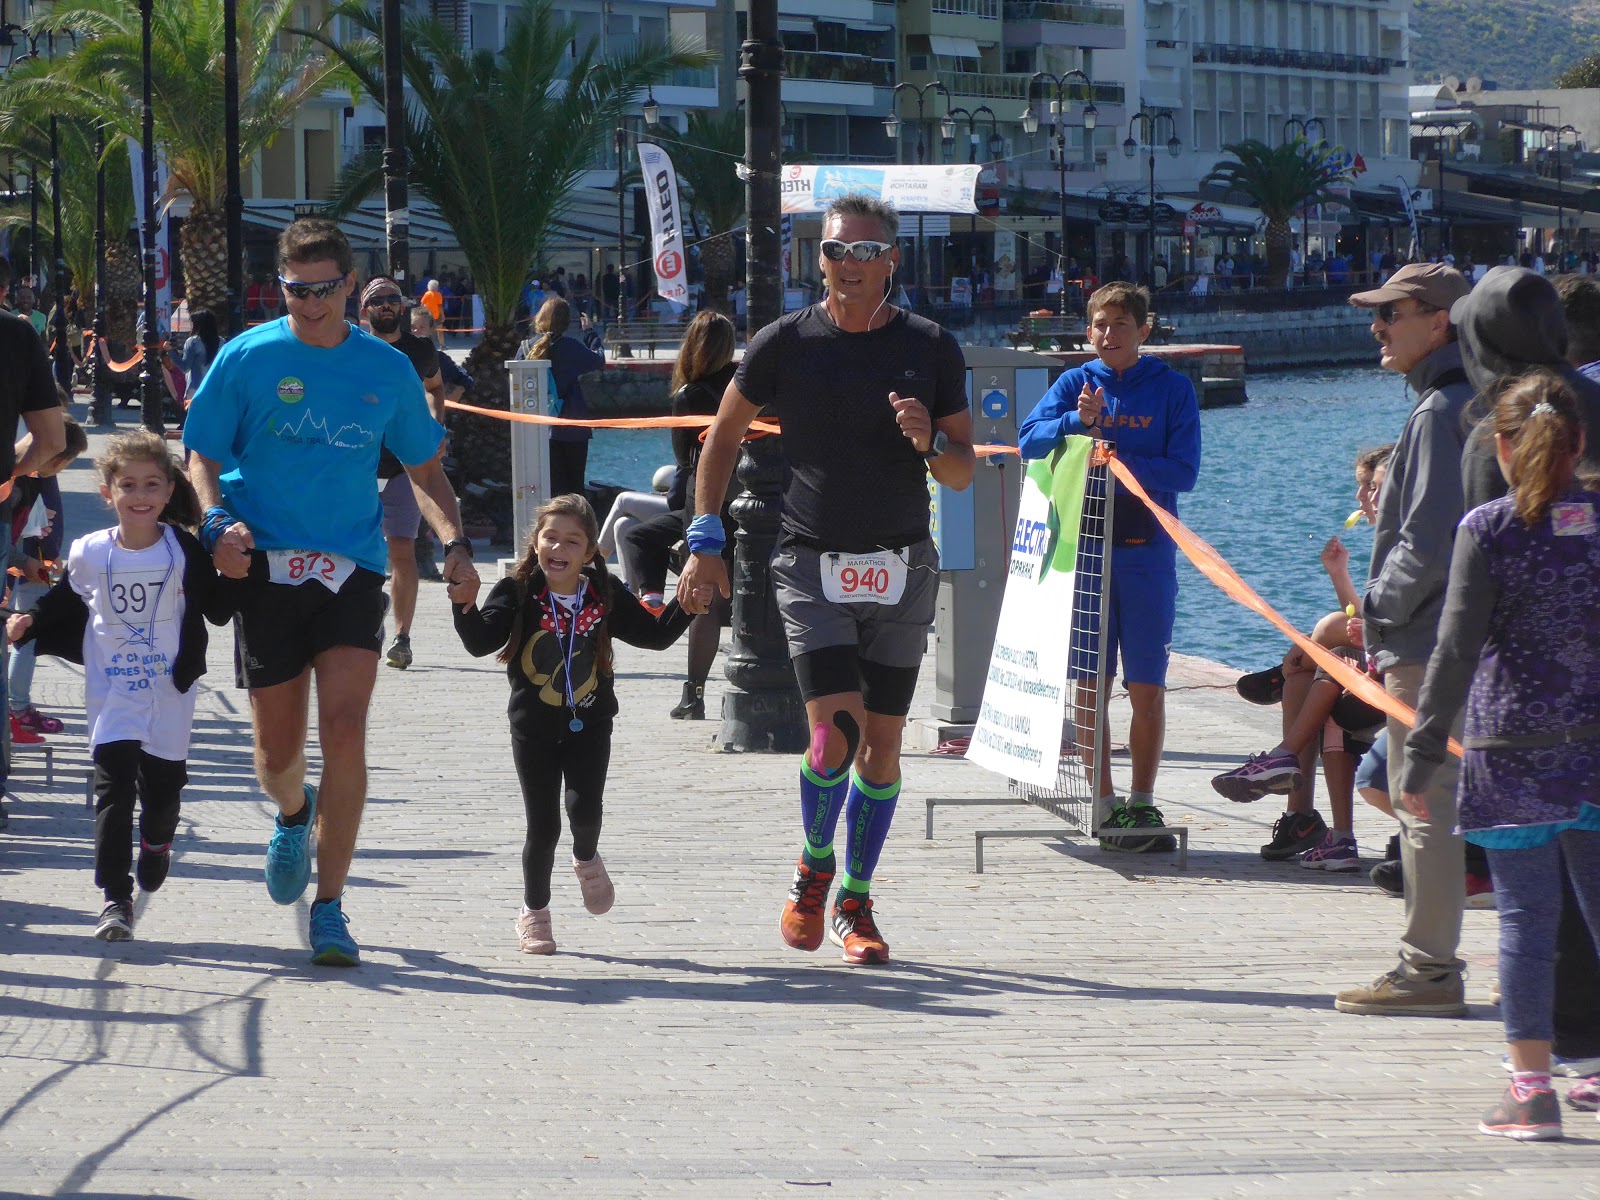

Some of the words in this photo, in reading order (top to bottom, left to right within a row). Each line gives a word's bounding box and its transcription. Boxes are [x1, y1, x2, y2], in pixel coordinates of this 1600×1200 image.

[991, 376, 998, 386] 2
[990, 426, 997, 435] 4
[288, 552, 336, 581] 872
[847, 559, 886, 567] MARATHON
[840, 567, 889, 594] 940
[111, 582, 165, 614] 397
